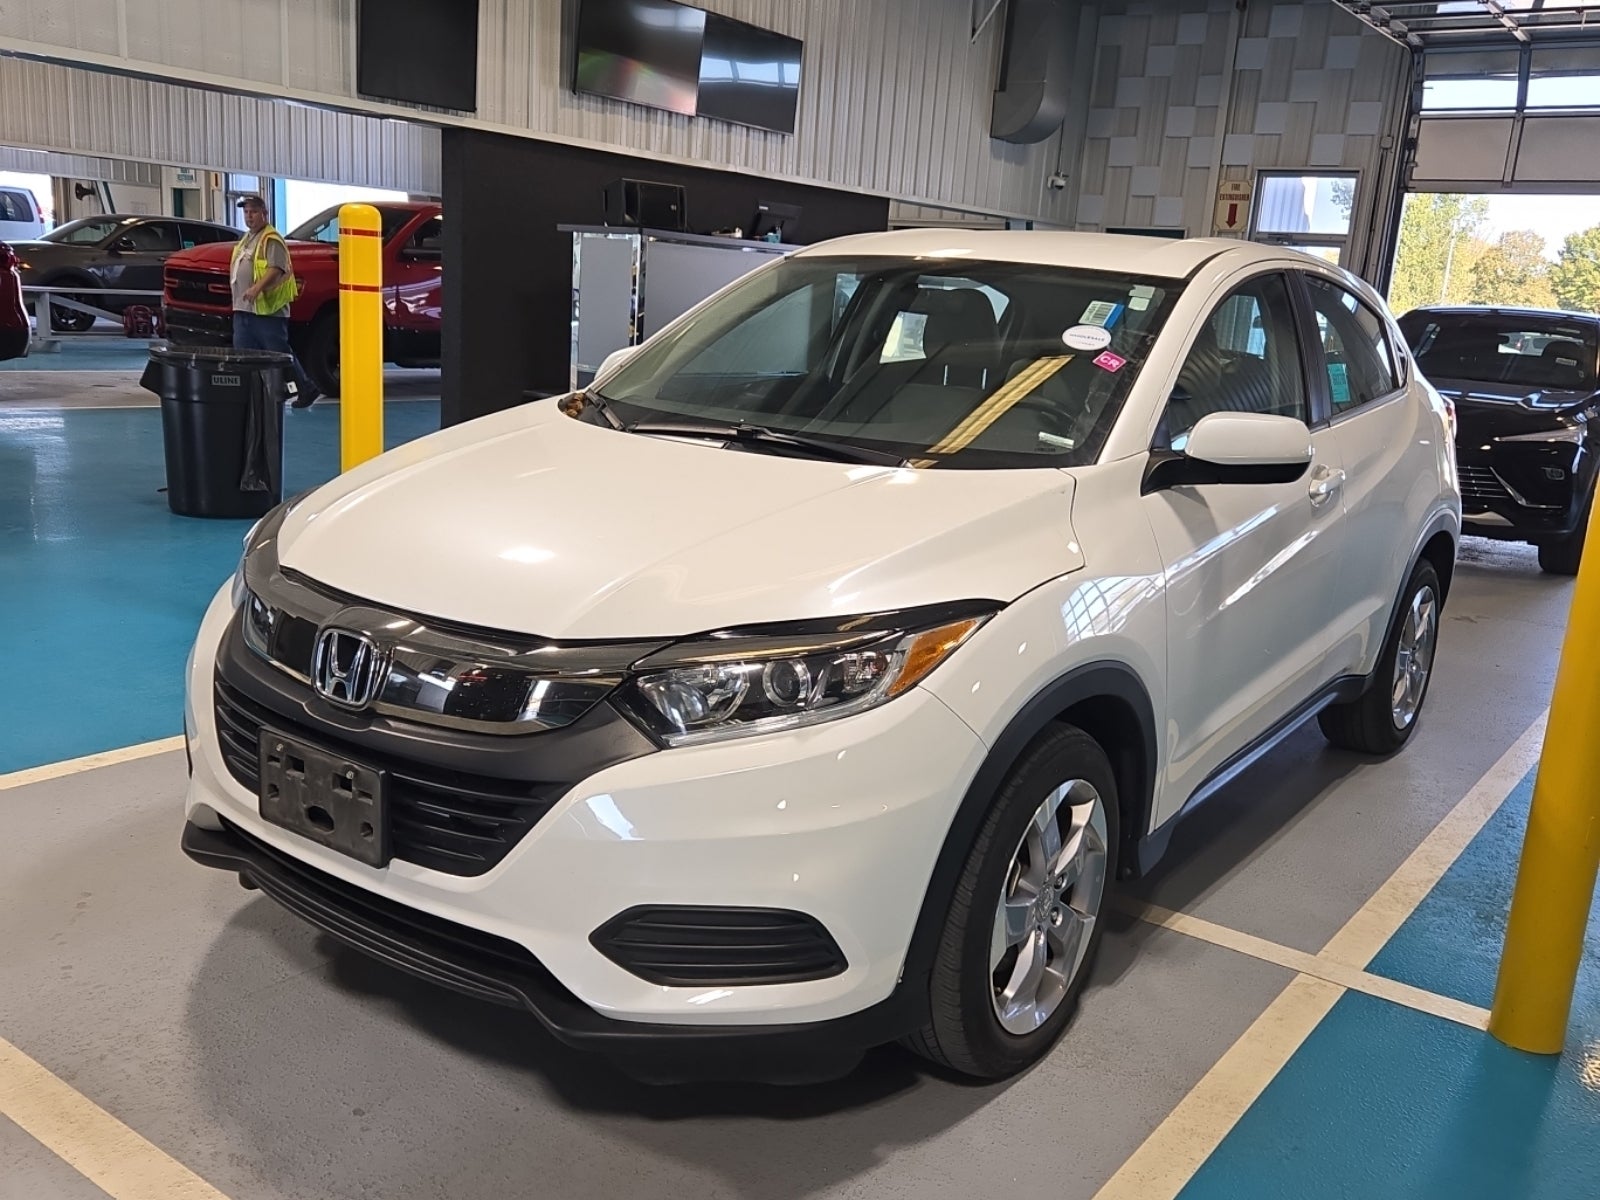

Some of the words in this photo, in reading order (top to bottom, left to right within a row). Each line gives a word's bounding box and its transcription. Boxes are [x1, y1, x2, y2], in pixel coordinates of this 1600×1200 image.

[1219, 193, 1250, 201] EXTINGUISHER
[1099, 355, 1121, 368] CR
[213, 375, 239, 385] ULINE
